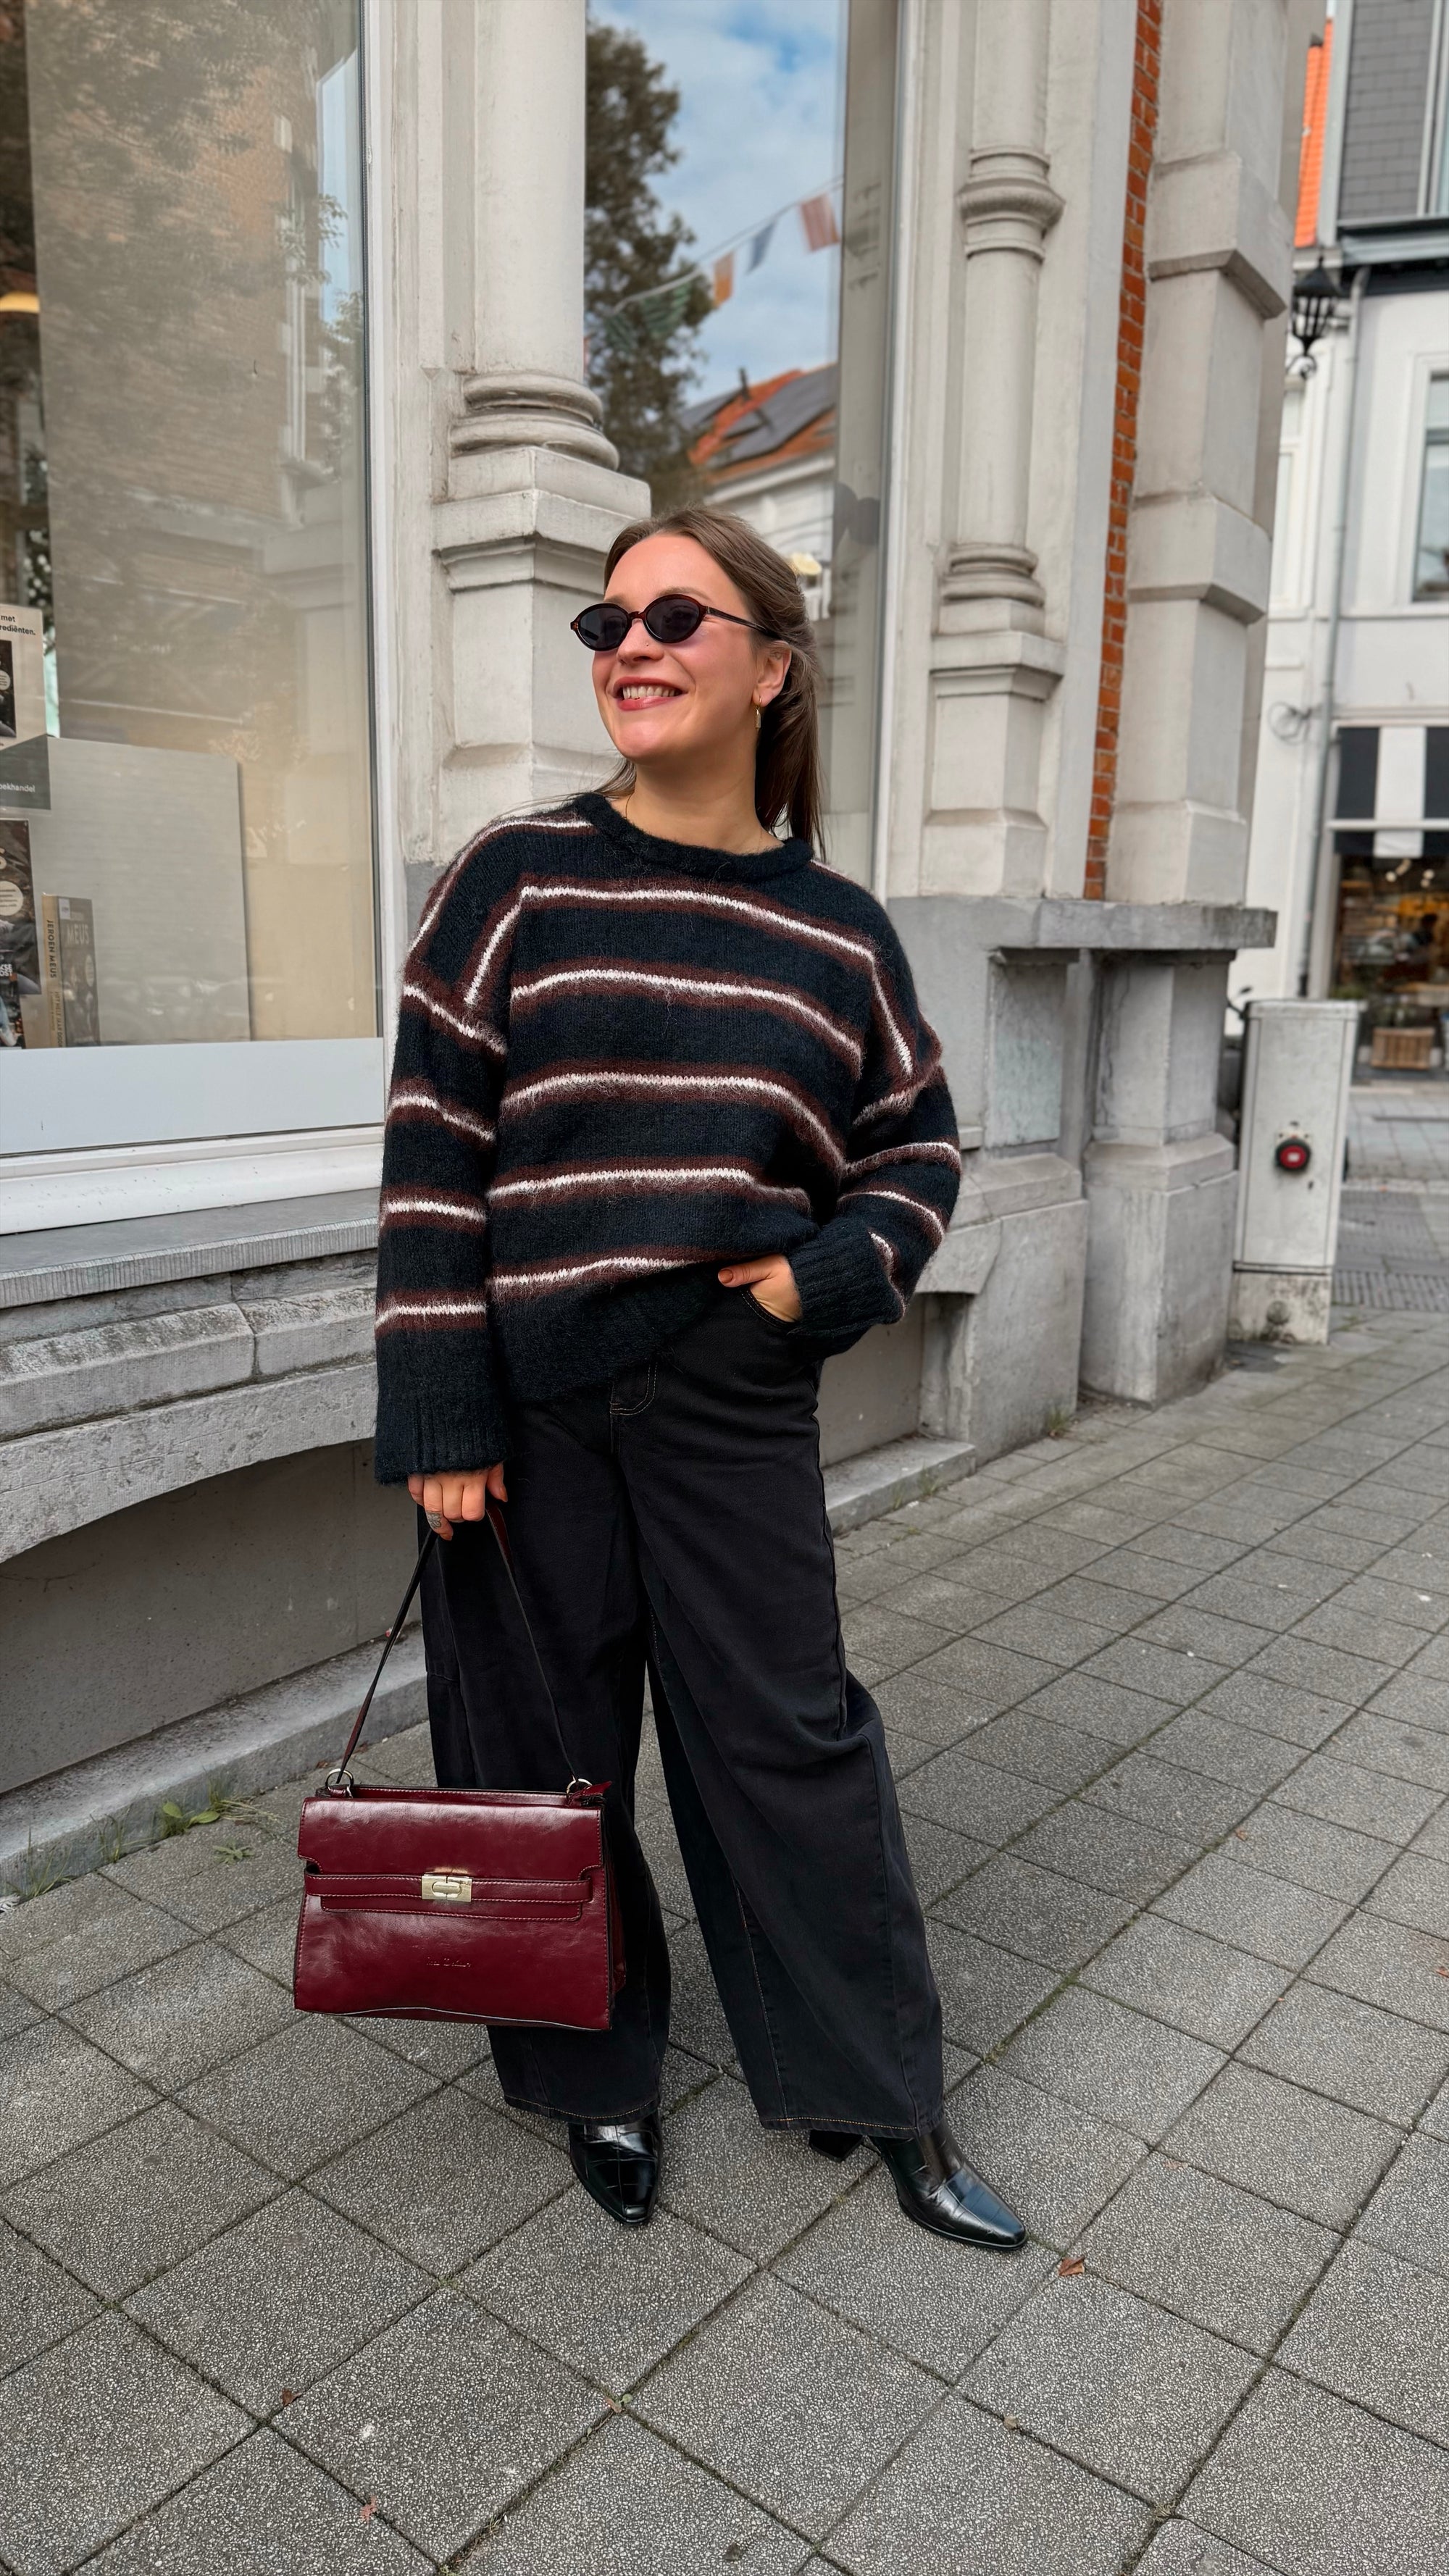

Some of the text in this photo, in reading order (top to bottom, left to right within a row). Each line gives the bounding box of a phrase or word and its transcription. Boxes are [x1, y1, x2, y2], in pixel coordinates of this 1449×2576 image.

[46, 920, 57, 978] JEROEN MEUS
[67, 924, 89, 945] MEUS
